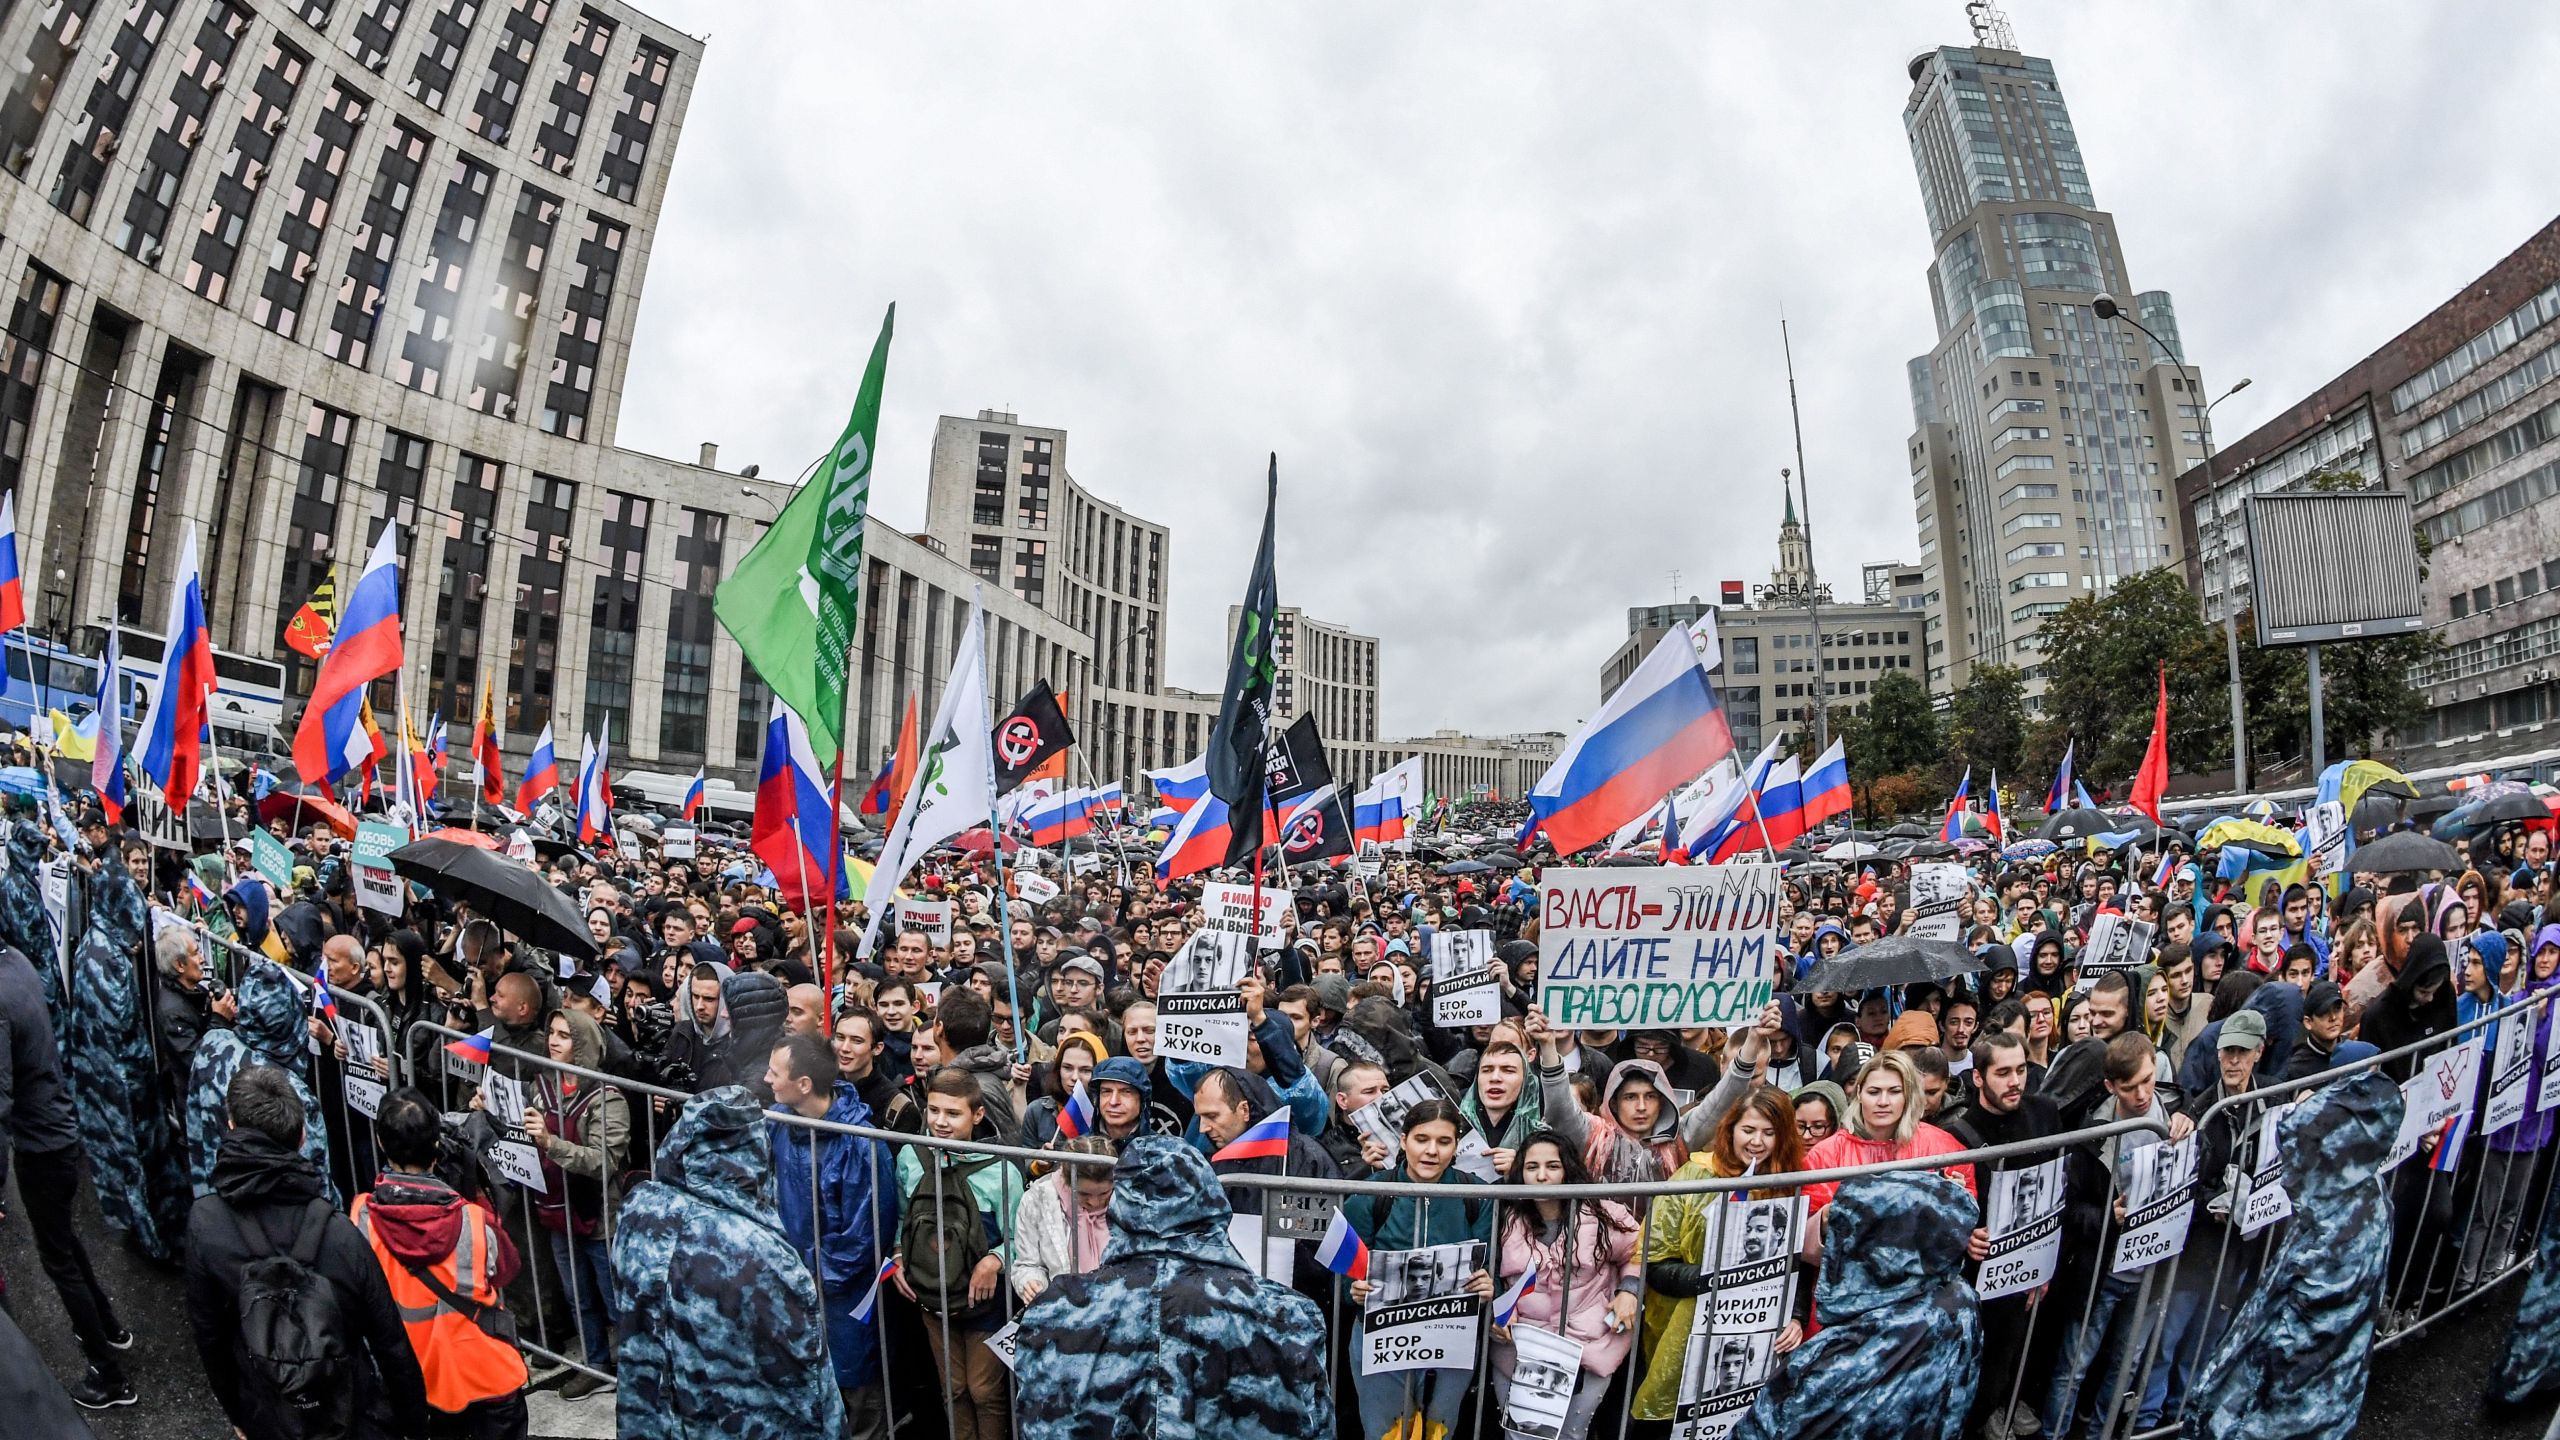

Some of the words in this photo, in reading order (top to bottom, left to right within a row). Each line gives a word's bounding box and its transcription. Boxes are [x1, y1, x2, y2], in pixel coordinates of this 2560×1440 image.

[363, 865, 392, 882] ЛУЧШЕ
[363, 878, 397, 897] МИТИНГ!
[1221, 891, 1230, 903] Я
[1232, 893, 1272, 908] ИМЮ
[1709, 867, 1778, 931] МЫ
[904, 910, 941, 923] ЛУЧШЕ
[1919, 902, 1959, 917] ТПУСКАЙ!
[1207, 917, 1224, 931] НА
[1911, 923, 1946, 933] ДАНИИЛ
[1547, 936, 1671, 979] ДАЙТЕ
[1691, 934, 1765, 979] НАМ
[1167, 995, 1241, 1011] ОТПУСКАЙ!
[1440, 1000, 1468, 1011] ЕГОР
[1439, 1010, 1483, 1021] ЖУКОВ
[1165, 1023, 1204, 1038] ЕГОР
[1163, 1036, 1222, 1056] ЖУКОВ
[349, 1081, 367, 1097] ЕГОР
[349, 1091, 377, 1114] ЖУКОВ
[493, 1147, 517, 1163] ЕГОР
[2255, 1166, 2283, 1188] ОТПУС
[2129, 1188, 2191, 1227] ОТПУСКАЙ!
[2250, 1193, 2274, 1211] ЕГОР
[2246, 1202, 2281, 1225] ЖУКОВ
[1989, 1216, 2059, 1256] ОТПУСКАЙ!
[2124, 1232, 2159, 1249] ЕГОР
[2121, 1240, 2171, 1263] ЖУКОВ
[1986, 1260, 2024, 1279] ЕГОР
[1983, 1268, 2039, 1292] ЖУКОВ
[1375, 1299, 1468, 1326] ОТПУСКАЙ!
[1701, 1311, 1767, 1326] ЖУКОВ
[1375, 1335, 1422, 1350] ЕГОР
[1373, 1348, 1445, 1365] ЖУКОВ
[1687, 1390, 1760, 1417] ОТПУСКА
